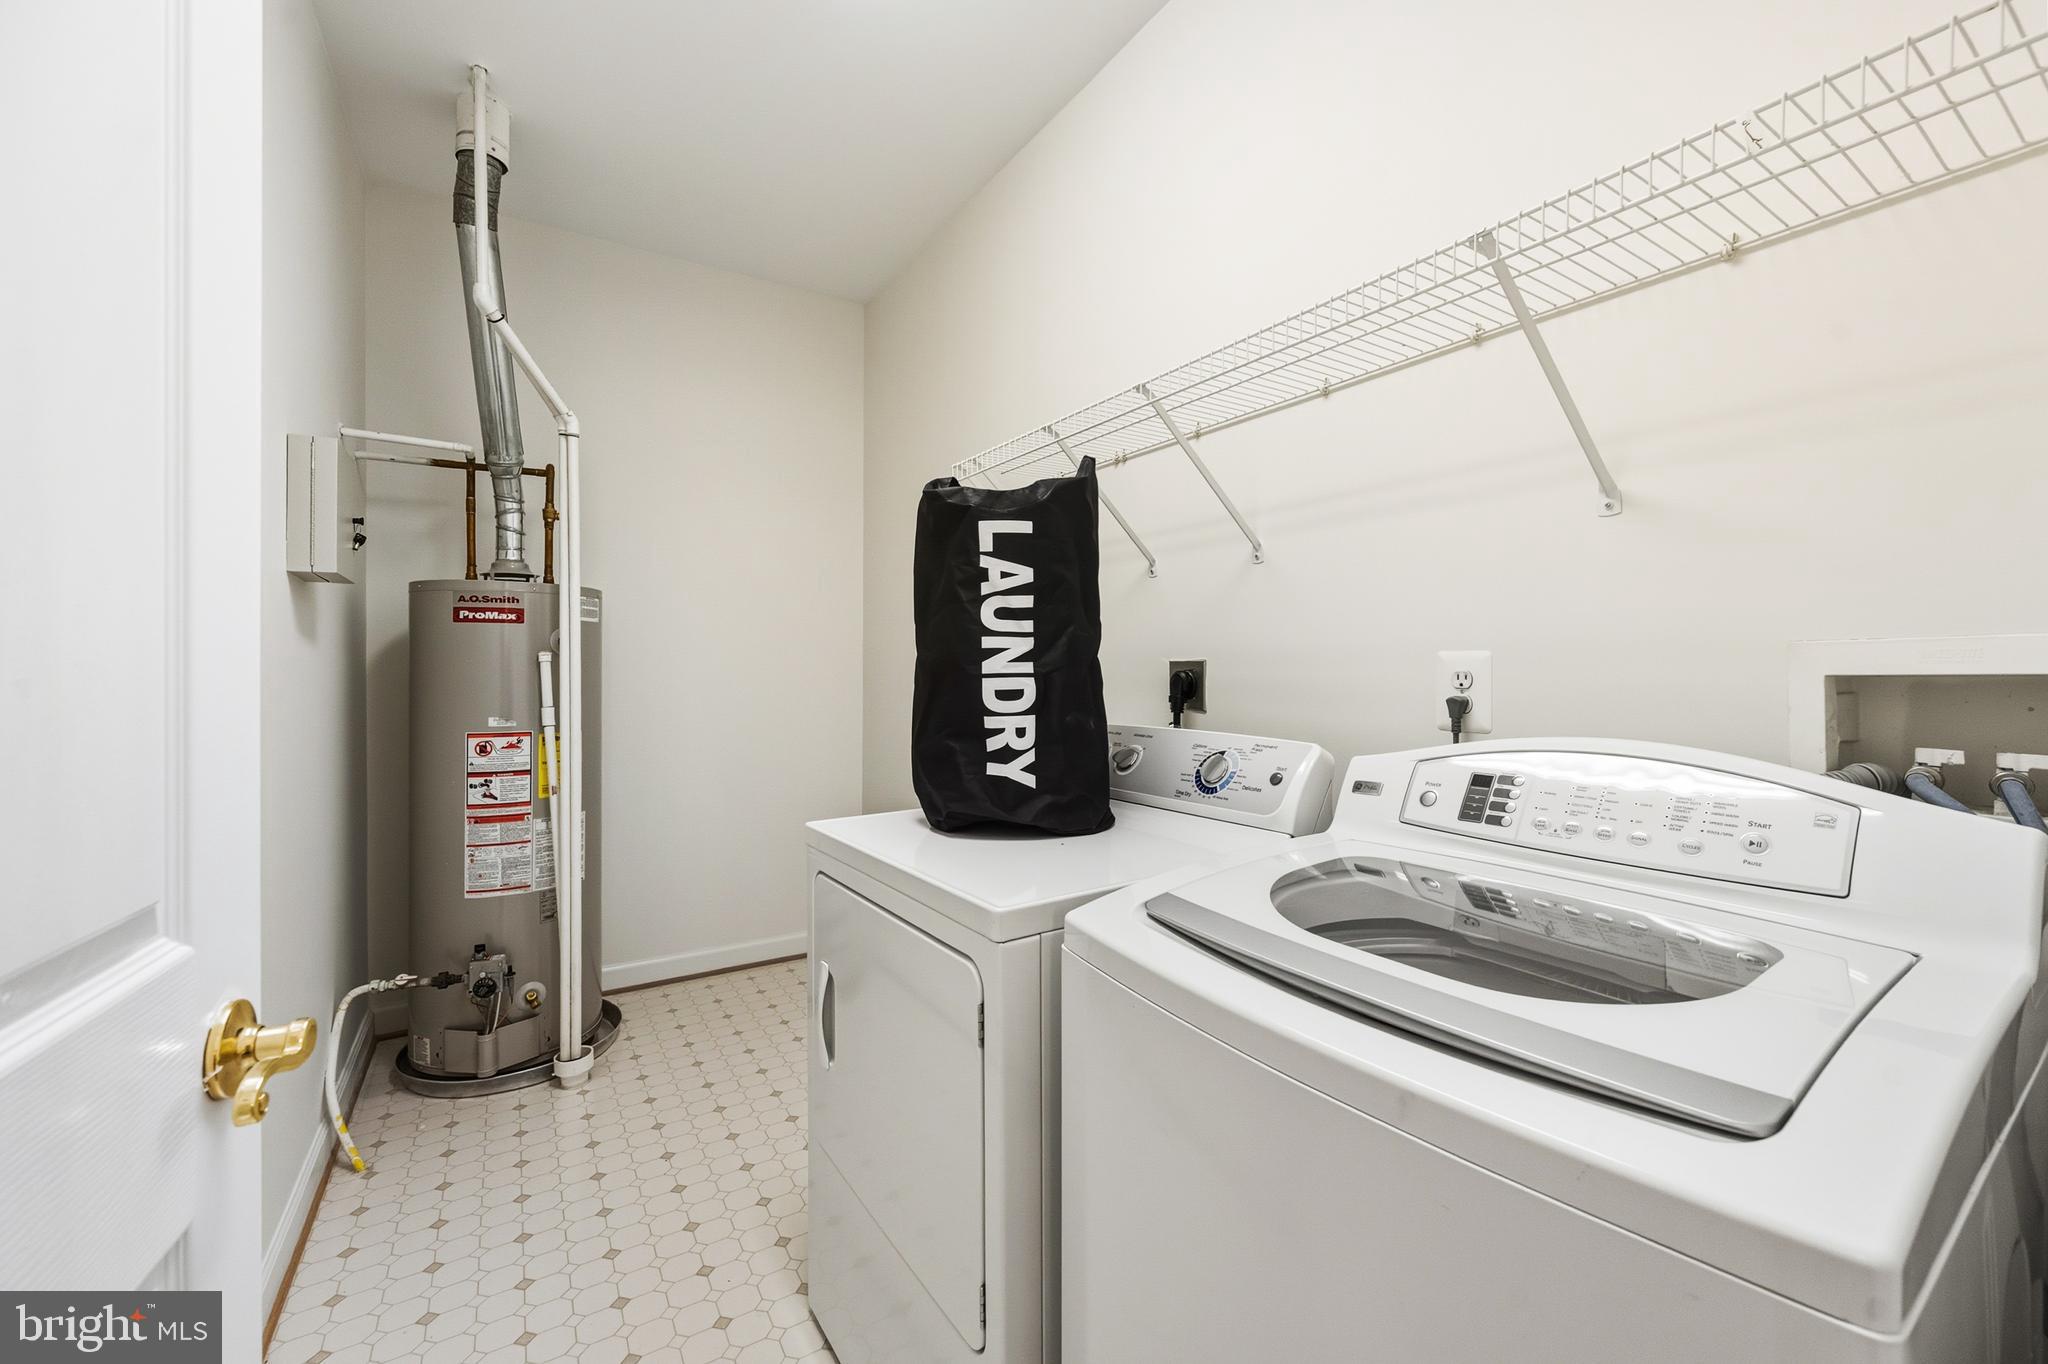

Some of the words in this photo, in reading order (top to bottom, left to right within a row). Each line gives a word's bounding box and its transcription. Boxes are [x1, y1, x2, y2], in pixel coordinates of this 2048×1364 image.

[458, 609, 518, 621] ProMax
[978, 520, 1036, 789] LAUNDRY
[1747, 821, 1772, 829] START
